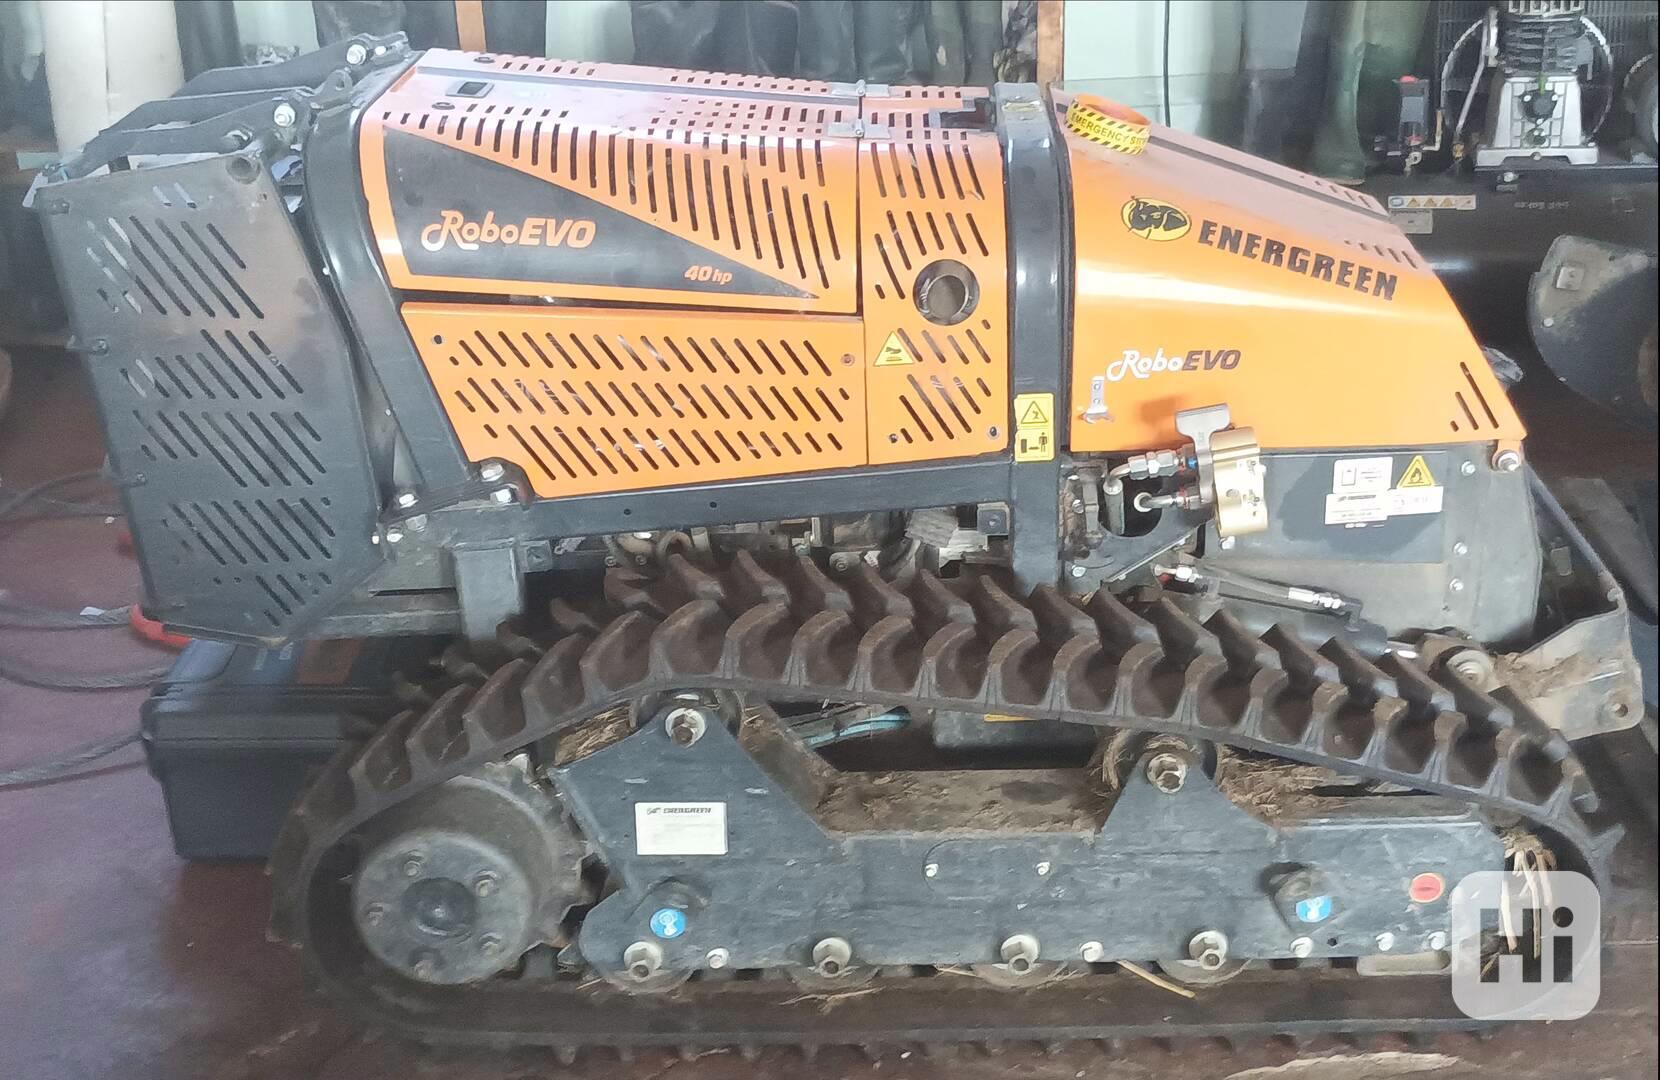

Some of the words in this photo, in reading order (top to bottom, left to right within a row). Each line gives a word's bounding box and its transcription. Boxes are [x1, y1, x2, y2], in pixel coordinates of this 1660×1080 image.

[1071, 111, 1130, 142] EMERGENCY
[421, 210, 596, 251] RoboEVO
[1198, 219, 1398, 301] ENERGREEN
[1106, 348, 1241, 382] RoboEVO
